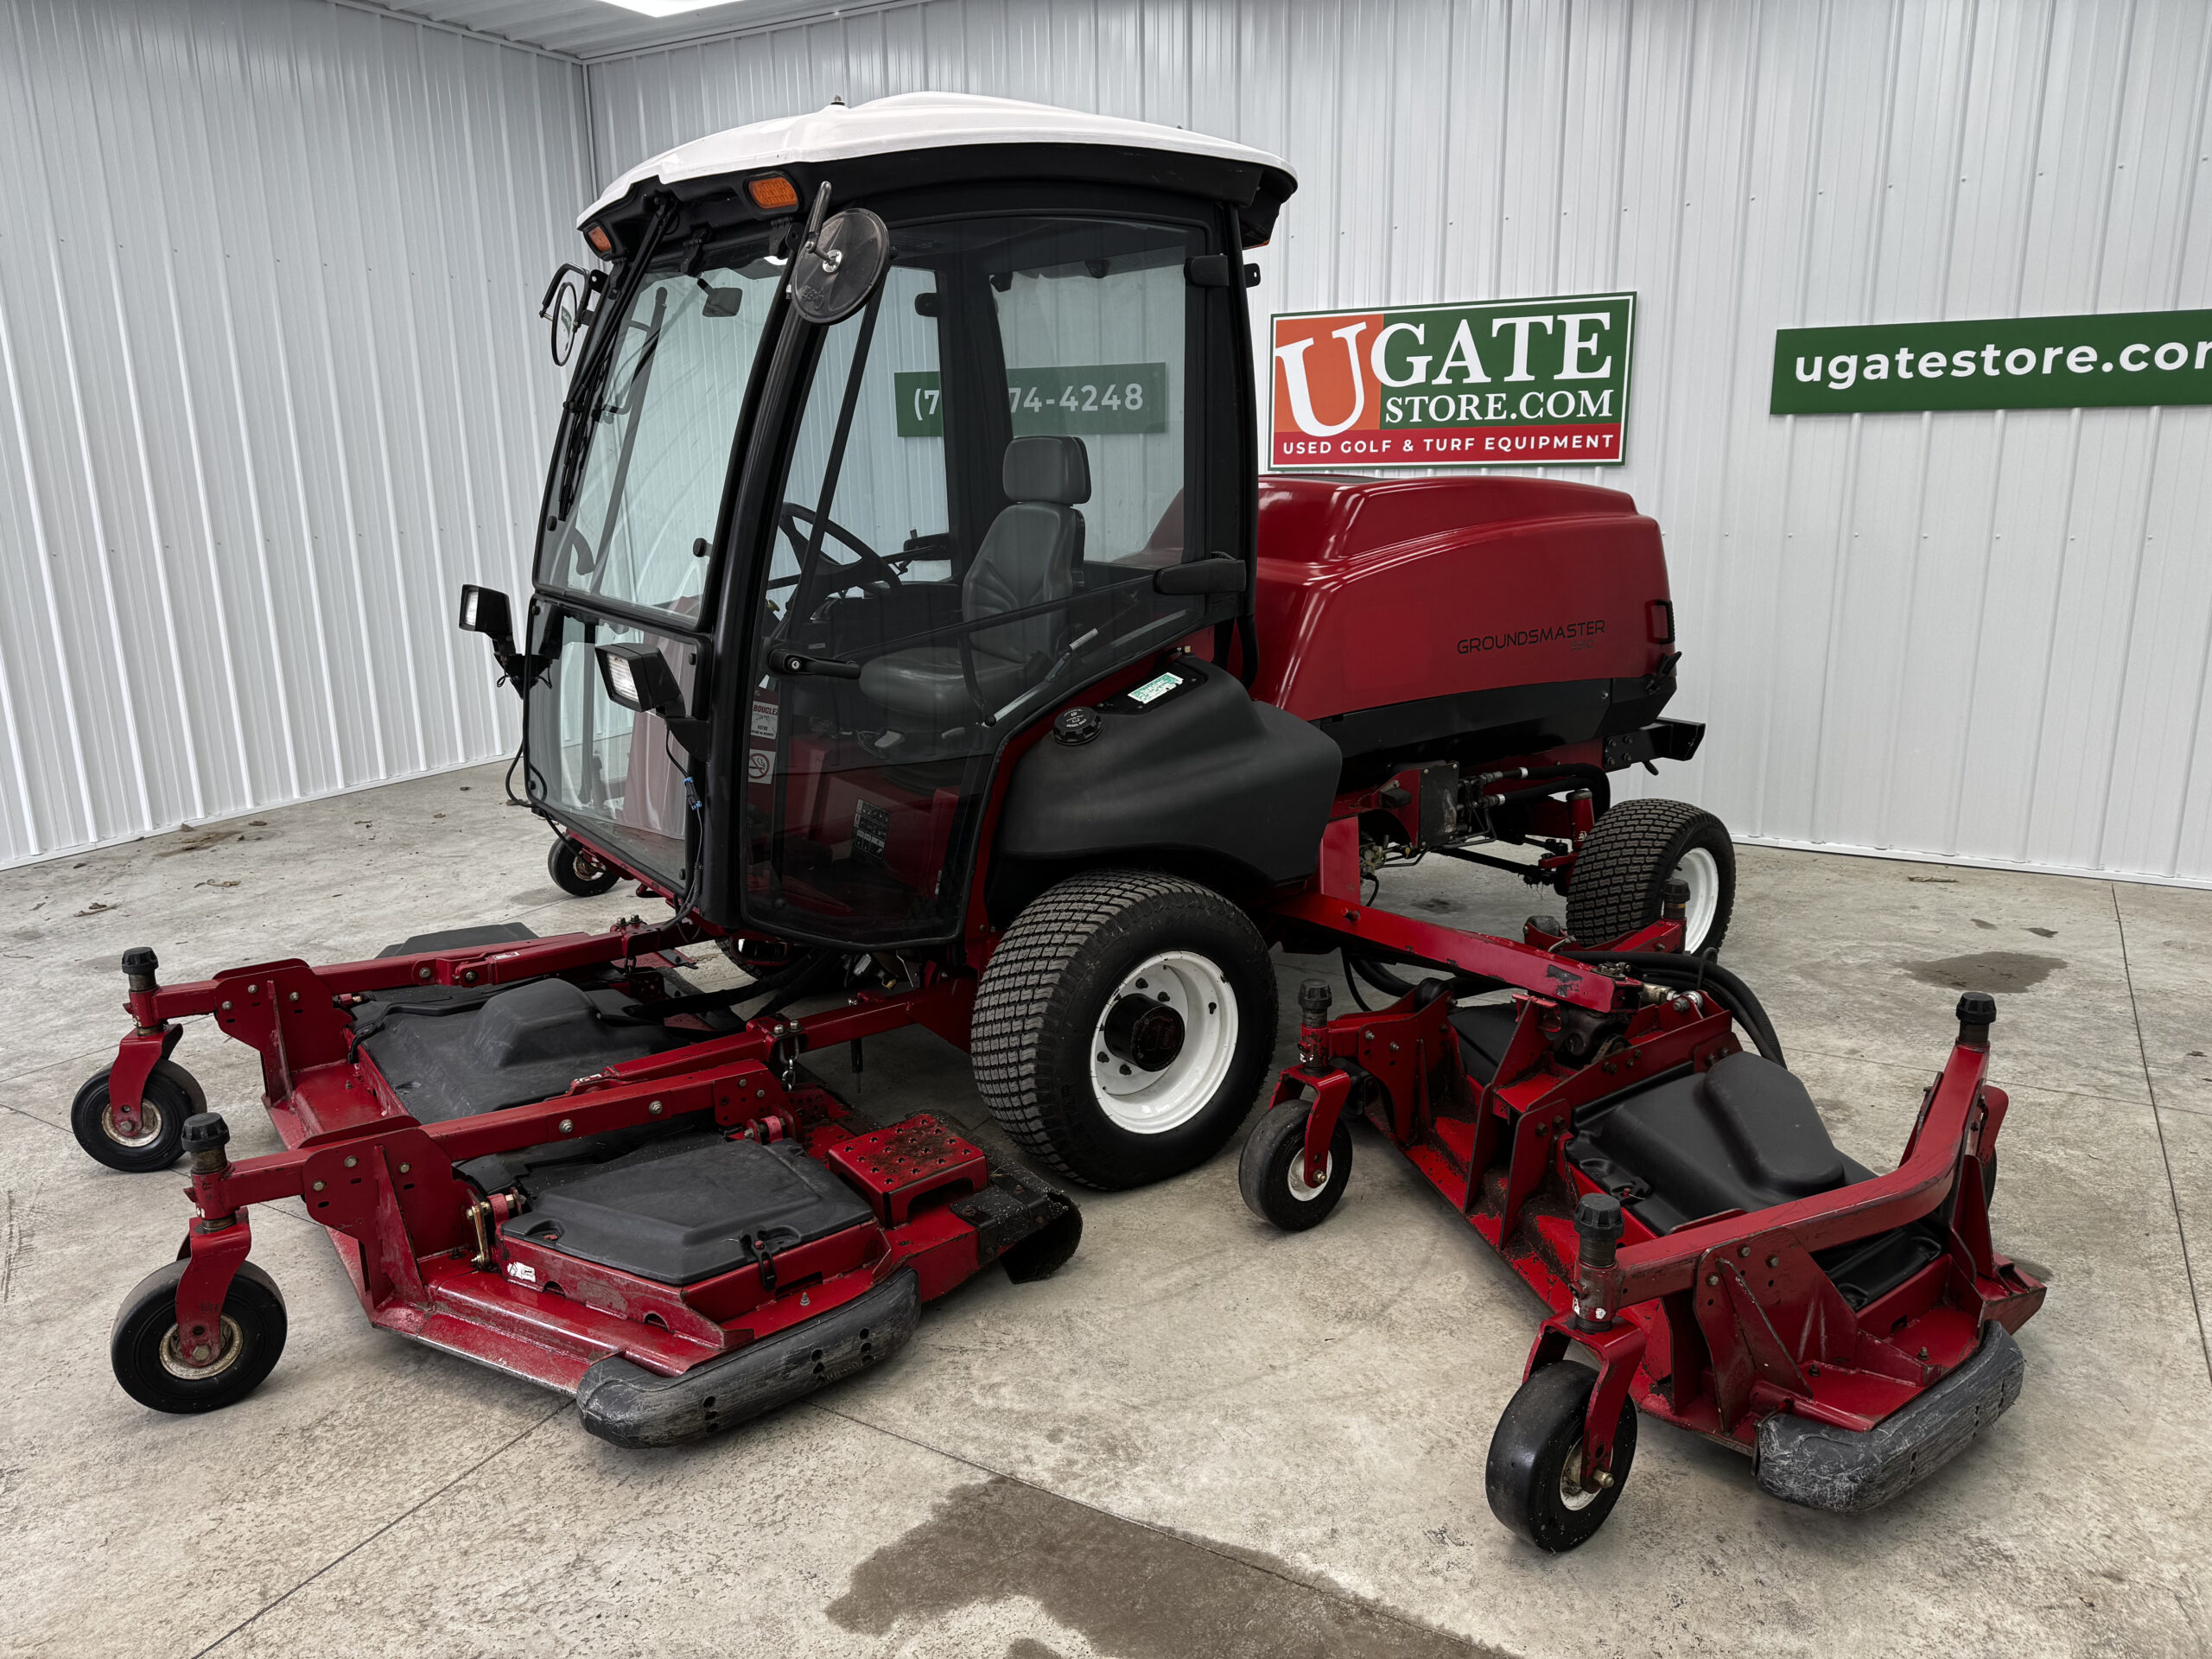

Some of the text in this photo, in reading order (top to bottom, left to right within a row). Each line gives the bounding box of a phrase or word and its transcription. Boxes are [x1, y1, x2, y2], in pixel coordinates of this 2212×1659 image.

[1008, 383, 1143, 413] 74-4248
[1385, 389, 1615, 423] STORE.COM
[1283, 434, 1614, 454] USED GOLF & TURF EQUIPMENT
[1457, 620, 1605, 654] GROUNDSMASTER
